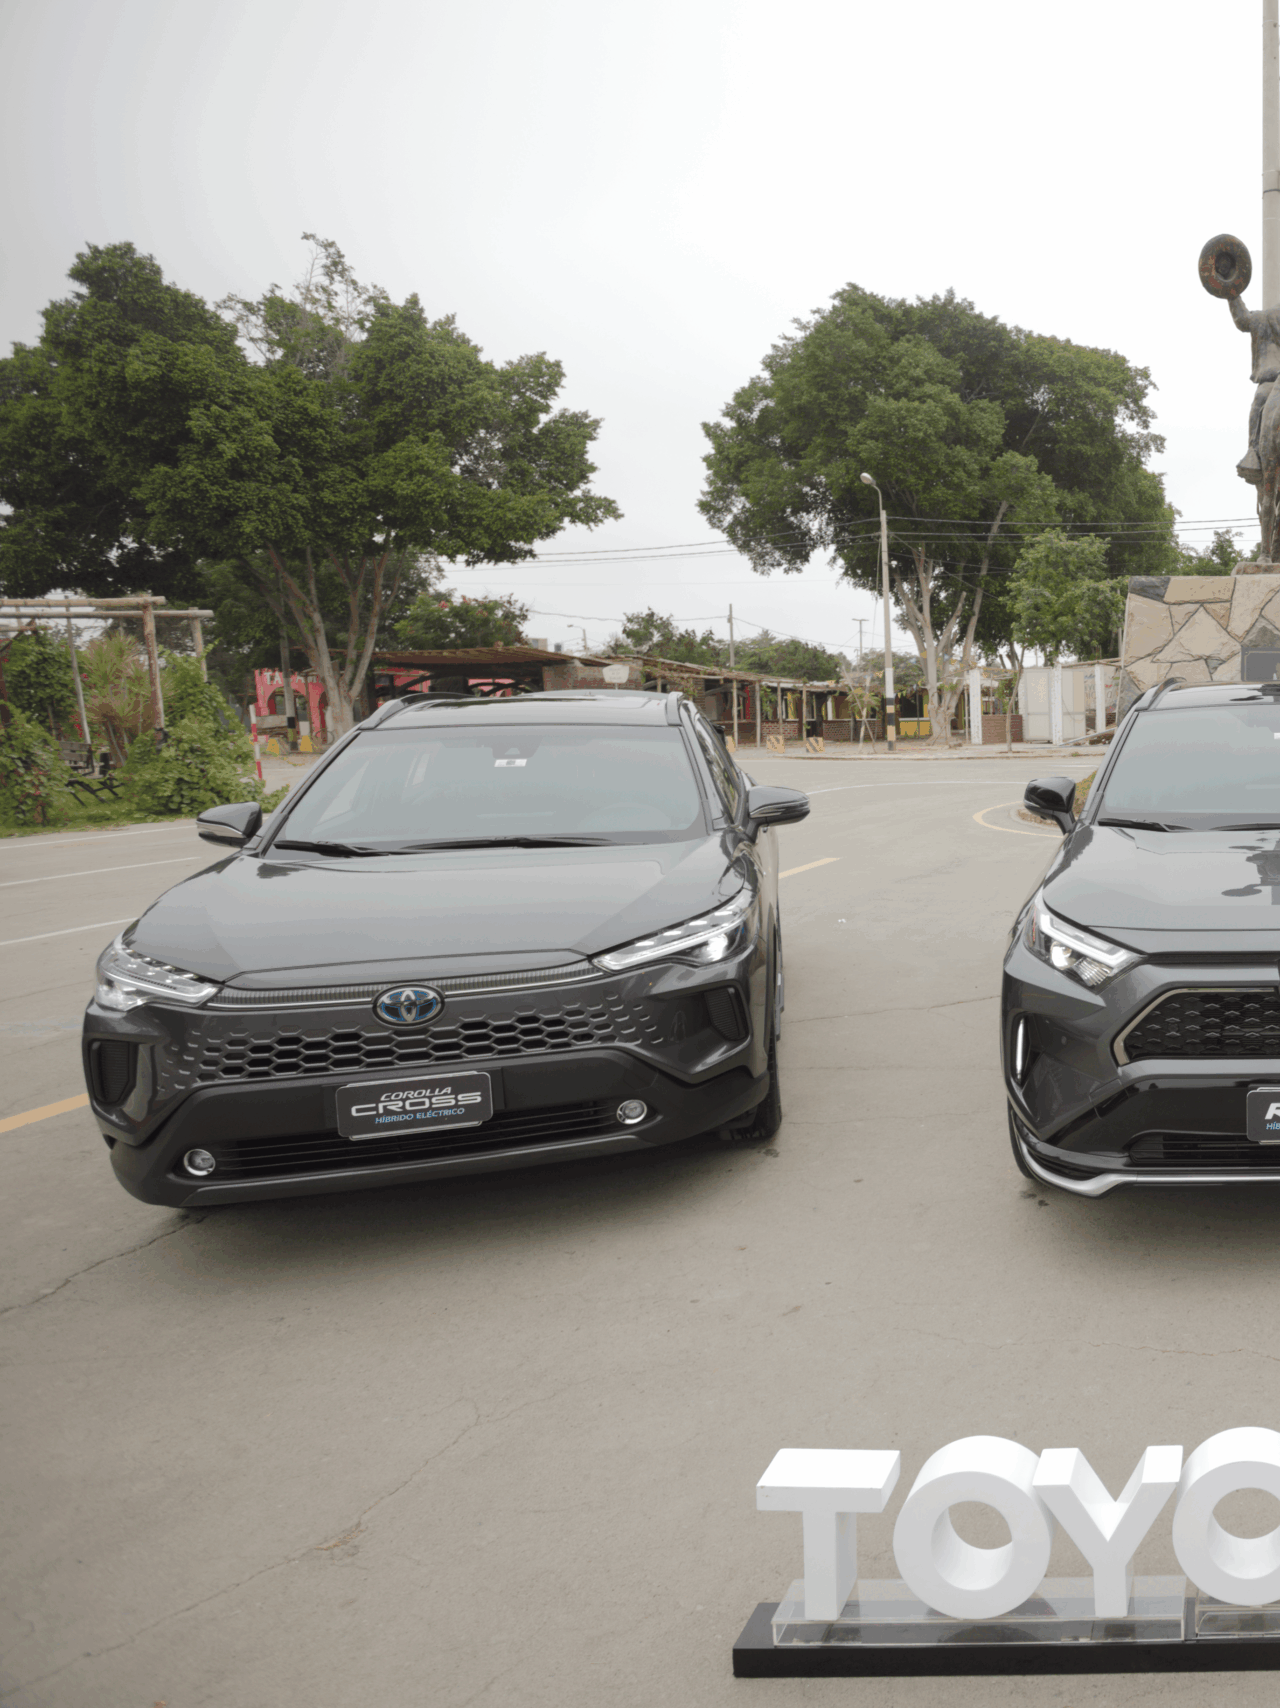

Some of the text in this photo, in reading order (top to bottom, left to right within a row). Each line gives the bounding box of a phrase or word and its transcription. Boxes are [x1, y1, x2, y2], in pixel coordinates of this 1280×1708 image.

[380, 1086, 452, 1101] COROLLA
[351, 1091, 482, 1117] CROSS
[375, 1107, 465, 1124] HÍBRIDO ELÉCTRICO
